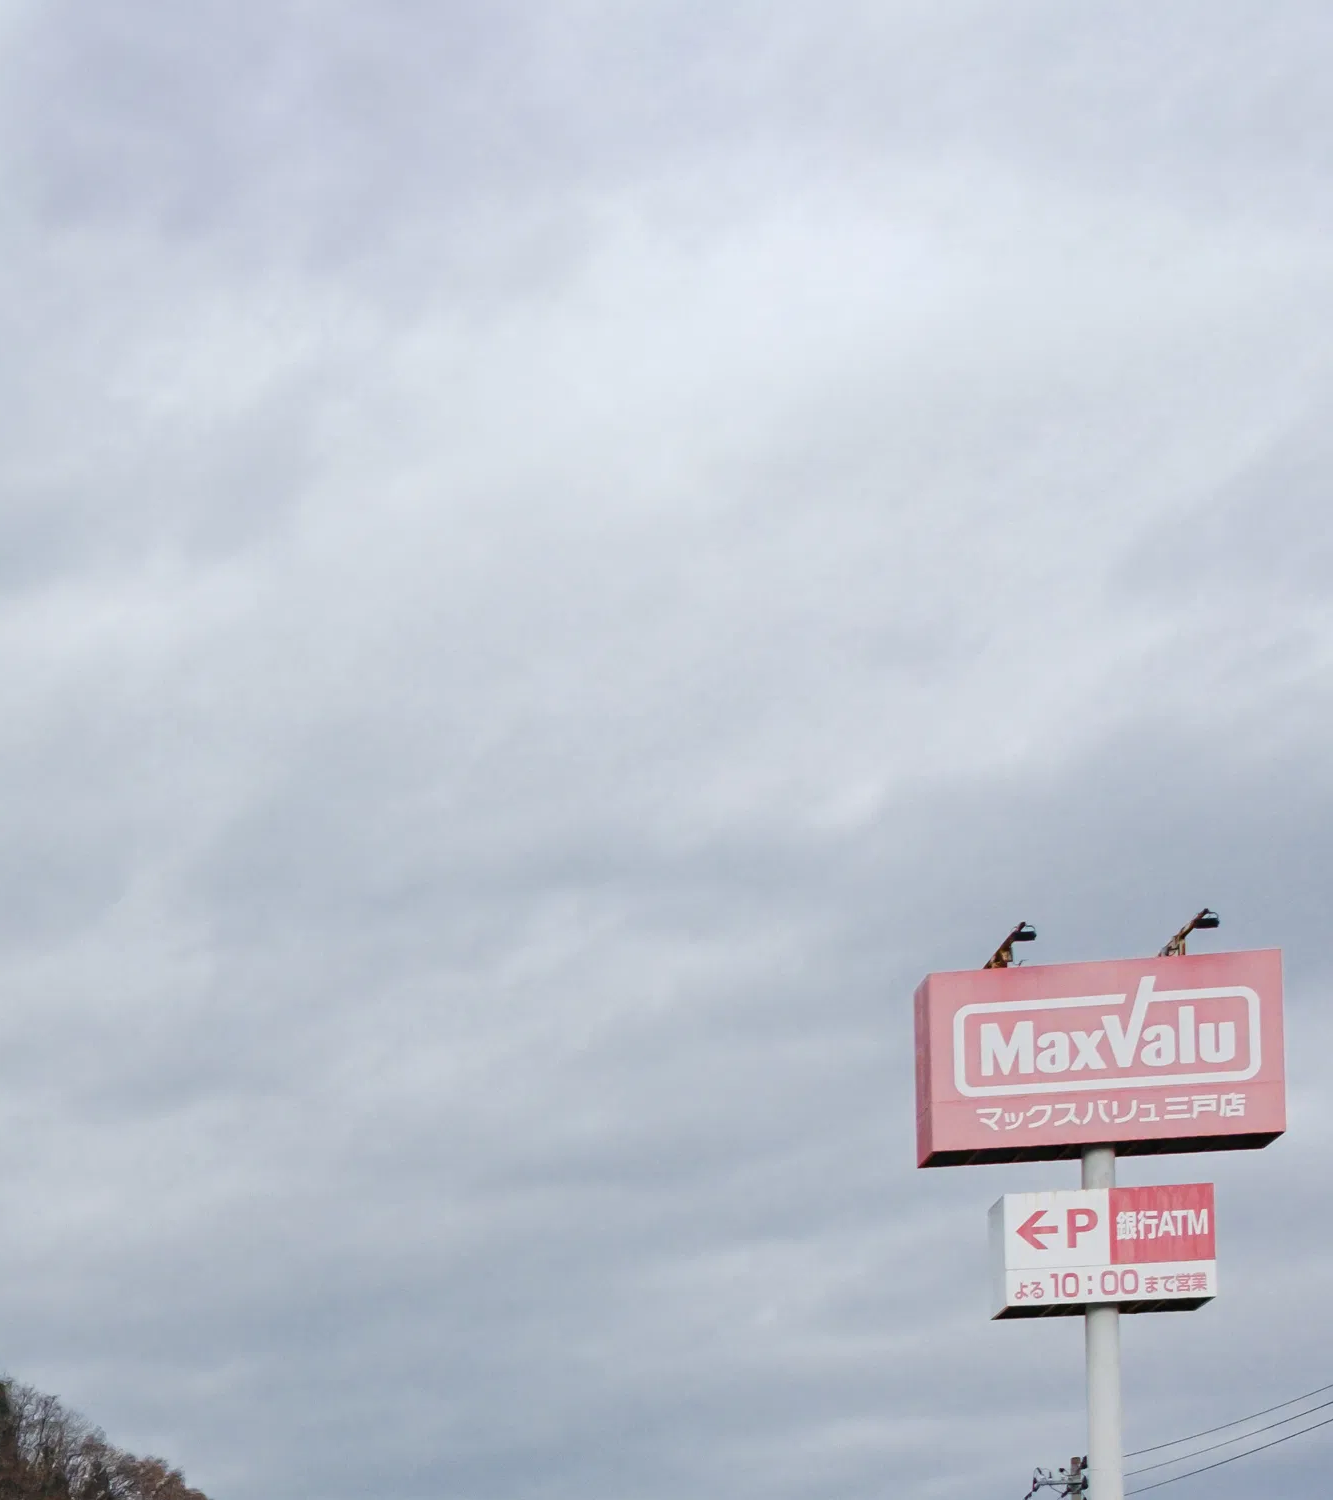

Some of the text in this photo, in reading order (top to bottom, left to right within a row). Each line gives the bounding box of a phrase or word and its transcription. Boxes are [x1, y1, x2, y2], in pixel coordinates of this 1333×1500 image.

[980, 976, 1235, 1077] MaxValu
[976, 1093, 1246, 1131] マックスバリュ三戸店
[1066, 1208, 1099, 1249] P
[1116, 1208, 1209, 1241] 銀行ATM
